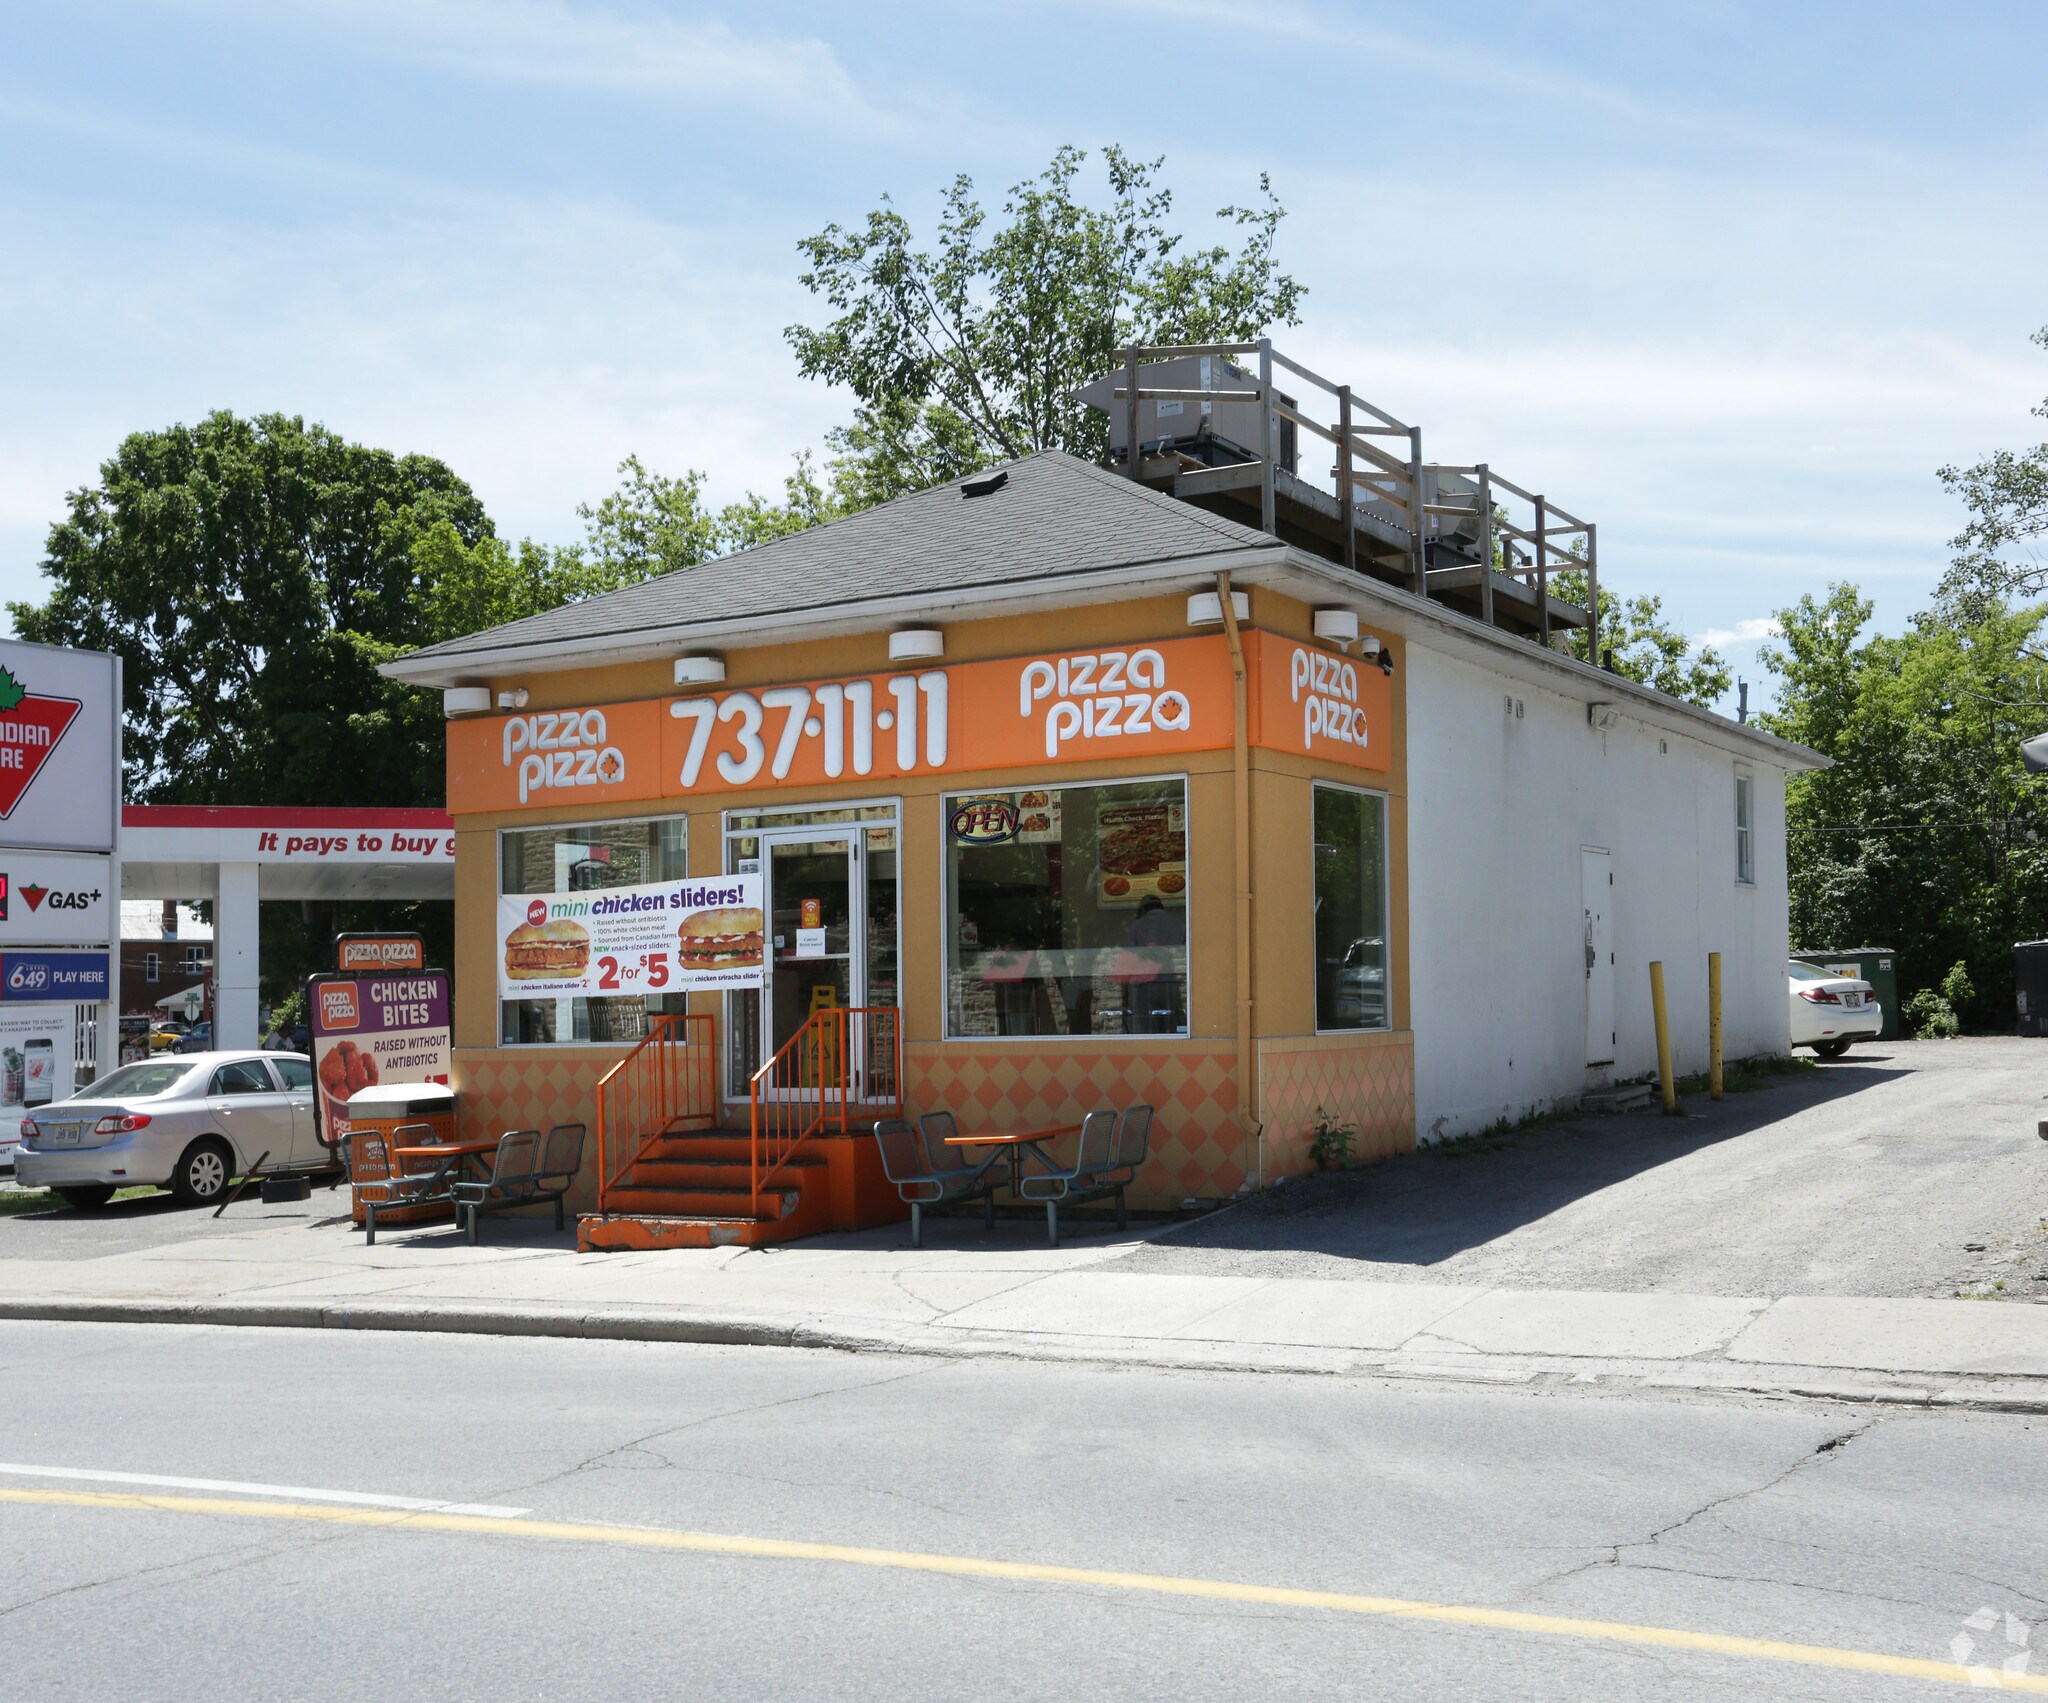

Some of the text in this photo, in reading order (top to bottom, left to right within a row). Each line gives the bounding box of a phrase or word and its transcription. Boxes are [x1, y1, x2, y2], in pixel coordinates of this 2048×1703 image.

[1020, 648, 1165, 718] pizza
[1291, 647, 1358, 703] pizza
[1045, 690, 1190, 758] pizza
[1304, 694, 1368, 750] pizza
[503, 708, 606, 767] pizza
[518, 746, 625, 804] pizza
[951, 807, 1019, 835] OPEN
[258, 832, 279, 851] It
[284, 836, 349, 856] pays
[356, 833, 383, 851] to
[390, 832, 438, 856] buy
[529, 884, 744, 919] NEW mini chicken sliders!
[616, 917, 637, 925] without
[638, 915, 667, 923] antibiotics
[593, 942, 671, 953] NEW snack-sized sliders:
[598, 936, 620, 944] Sourced
[635, 933, 661, 941] Canadian
[344, 942, 417, 968] pizza pizza
[53, 971, 104, 983] PLAY HERE
[597, 953, 669, 990] 2 for $5
[694, 975, 717, 983] chicken
[718, 973, 742, 981] sriracha
[371, 980, 438, 1003] CHICKEN
[521, 983, 542, 991] chicken
[542, 982, 563, 990] italiano
[564, 981, 580, 989] slider
[323, 992, 350, 1010] pizza
[328, 1004, 355, 1024] pizza
[383, 1003, 429, 1027] BITES
[374, 1034, 447, 1053] RAISED WITHOUT
[385, 1052, 438, 1070] ANTIBIOTICS
